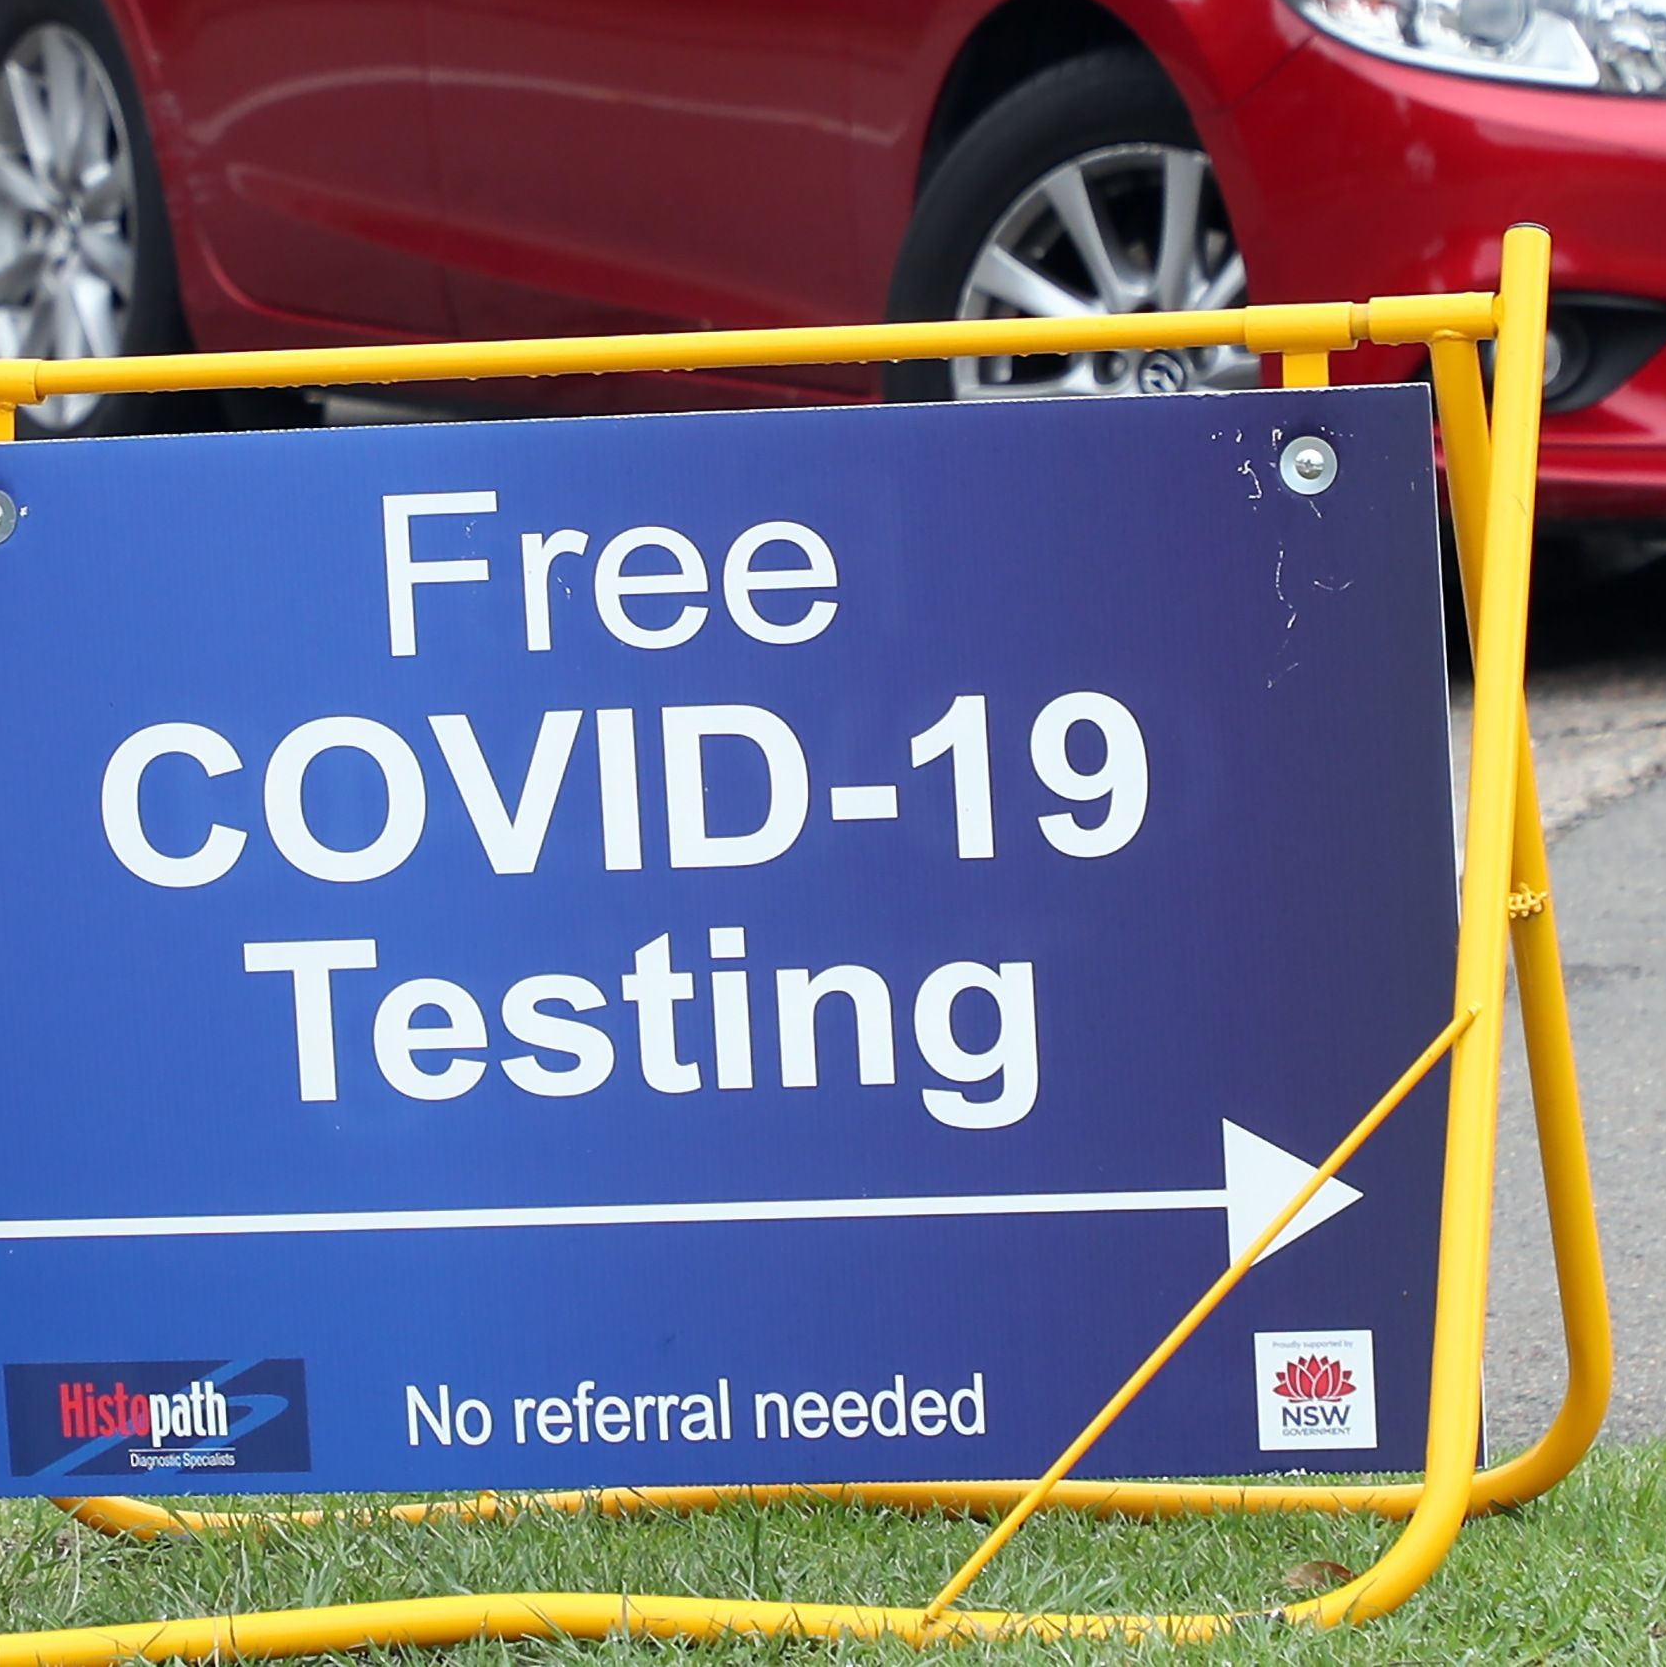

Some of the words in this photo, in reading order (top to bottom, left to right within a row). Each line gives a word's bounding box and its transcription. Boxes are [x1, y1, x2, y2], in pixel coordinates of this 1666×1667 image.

[383, 491, 837, 656] Free
[102, 692, 1147, 887] COVID-19
[244, 927, 1038, 1128] Testing
[59, 1381, 227, 1447] Histopath
[407, 1385, 491, 1445] No
[515, 1379, 730, 1443] referral
[756, 1373, 985, 1438] needed
[1282, 1404, 1350, 1427] NSW
[1283, 1427, 1351, 1437] GOVERNMENT
[130, 1453, 182, 1470] Diagnostic
[183, 1452, 235, 1468] Specialists
